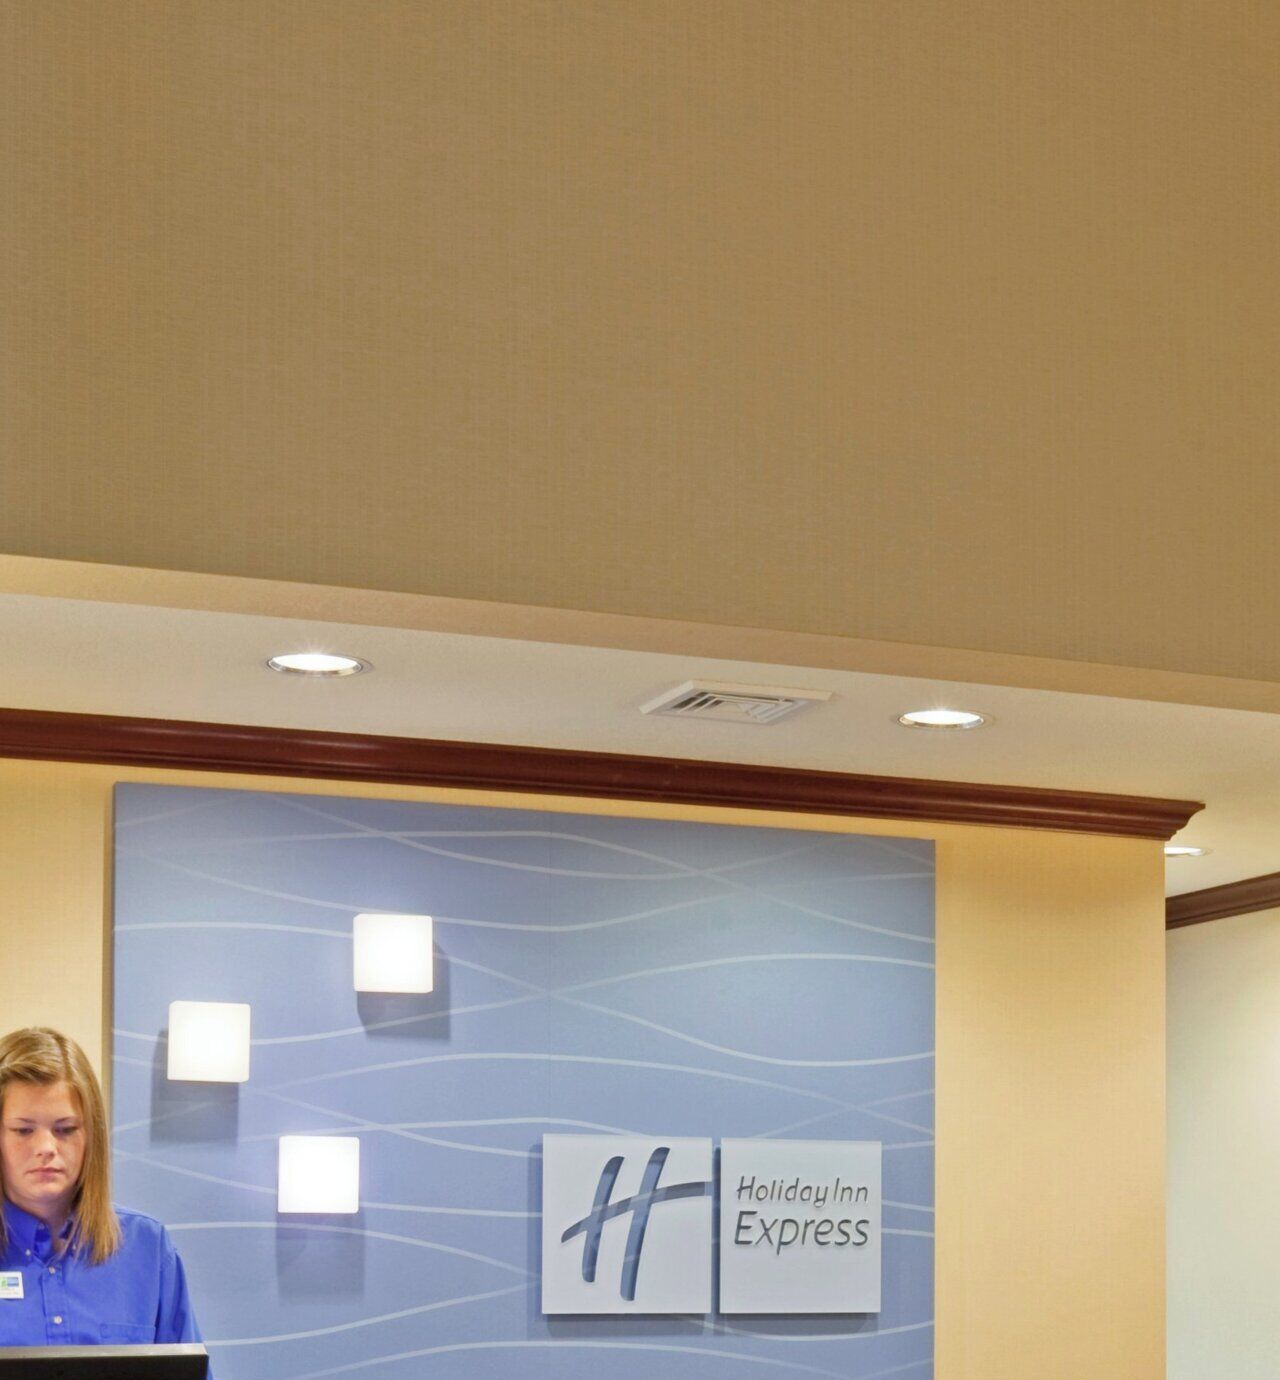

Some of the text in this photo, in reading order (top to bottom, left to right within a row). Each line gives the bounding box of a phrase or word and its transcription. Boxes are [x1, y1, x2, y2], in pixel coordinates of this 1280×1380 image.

[736, 1175, 869, 1208] Holiday Inn
[734, 1210, 871, 1256] Express
